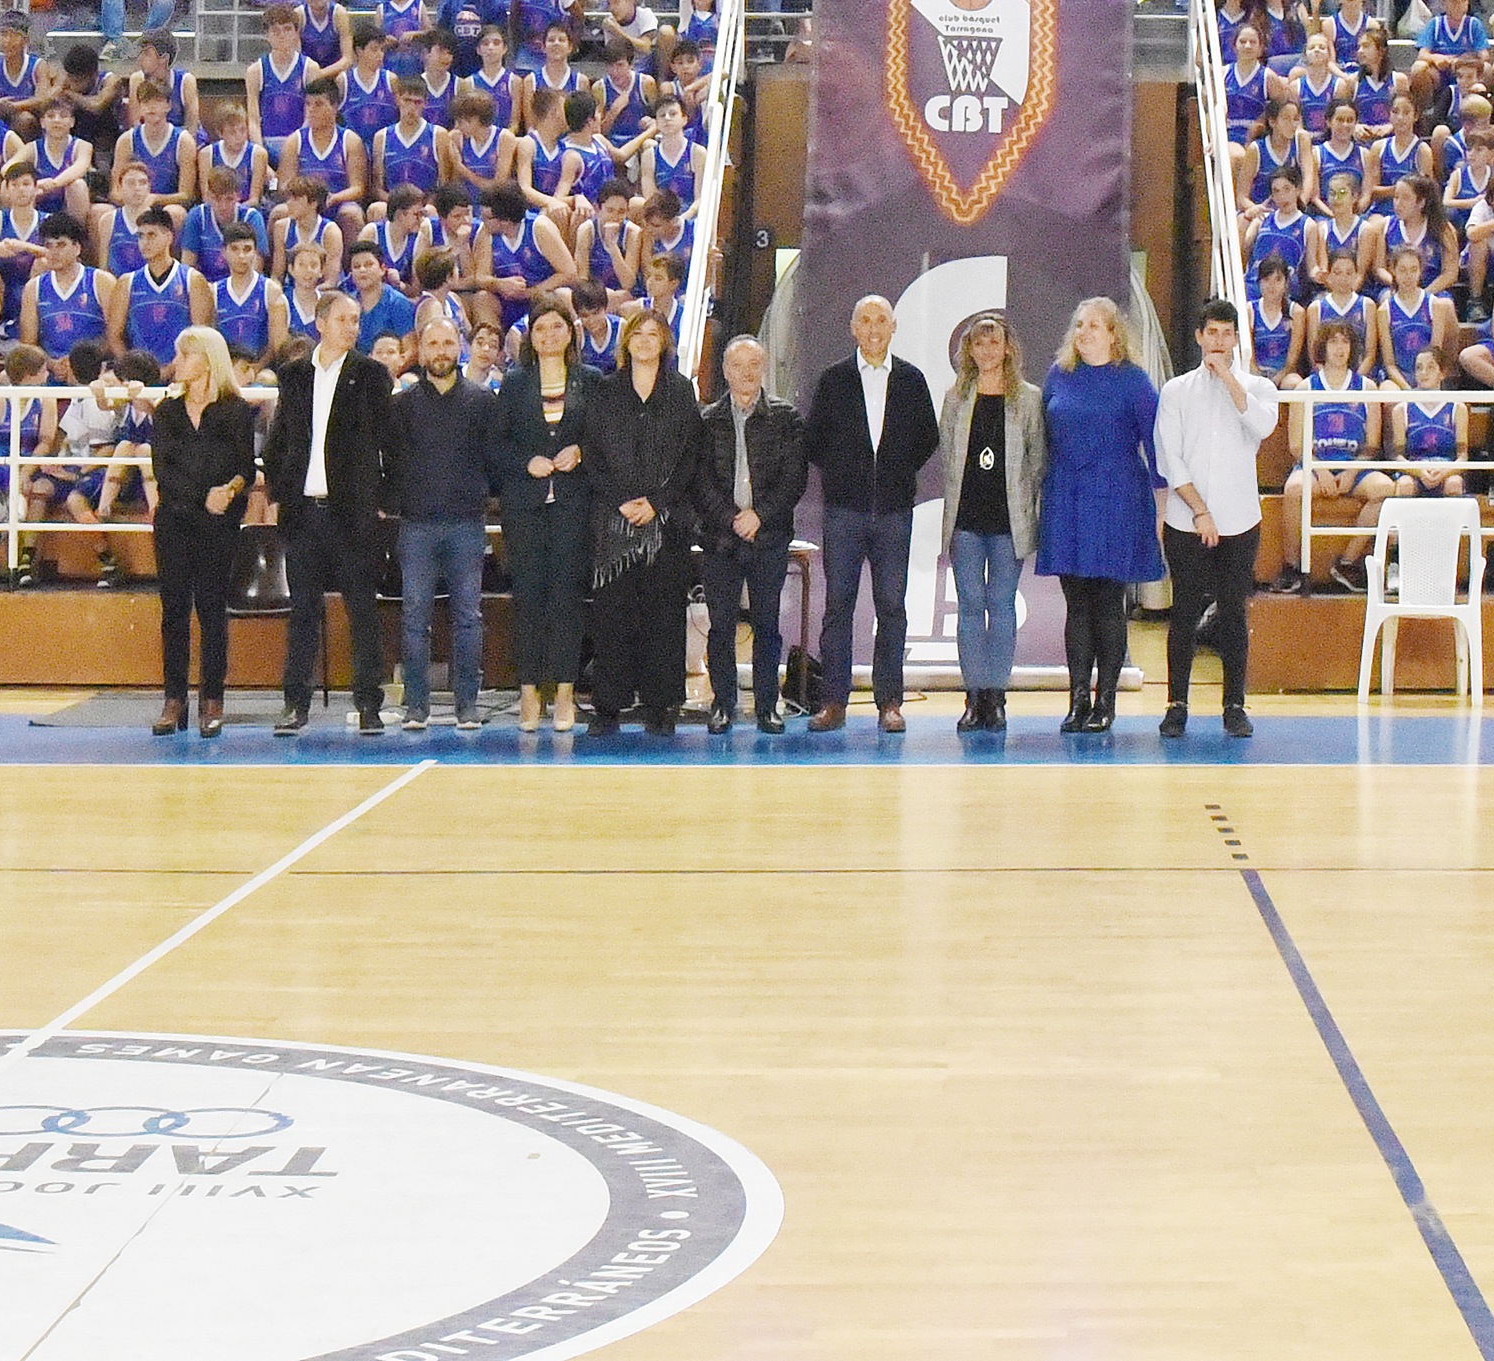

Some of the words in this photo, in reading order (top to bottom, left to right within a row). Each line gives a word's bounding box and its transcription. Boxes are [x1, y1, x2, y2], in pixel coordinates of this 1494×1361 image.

[939, 14, 959, 22] club
[455, 25, 481, 36] CBT
[946, 25, 993, 34] Tarragona
[926, 95, 1008, 133] CBT
[756, 230, 769, 248] 3
[74, 1043, 279, 1065] GAMES
[300, 1057, 661, 1155] MEDITERRANEAN
[629, 1158, 698, 1199] XVIII
[149, 1183, 322, 1199] XVIII
